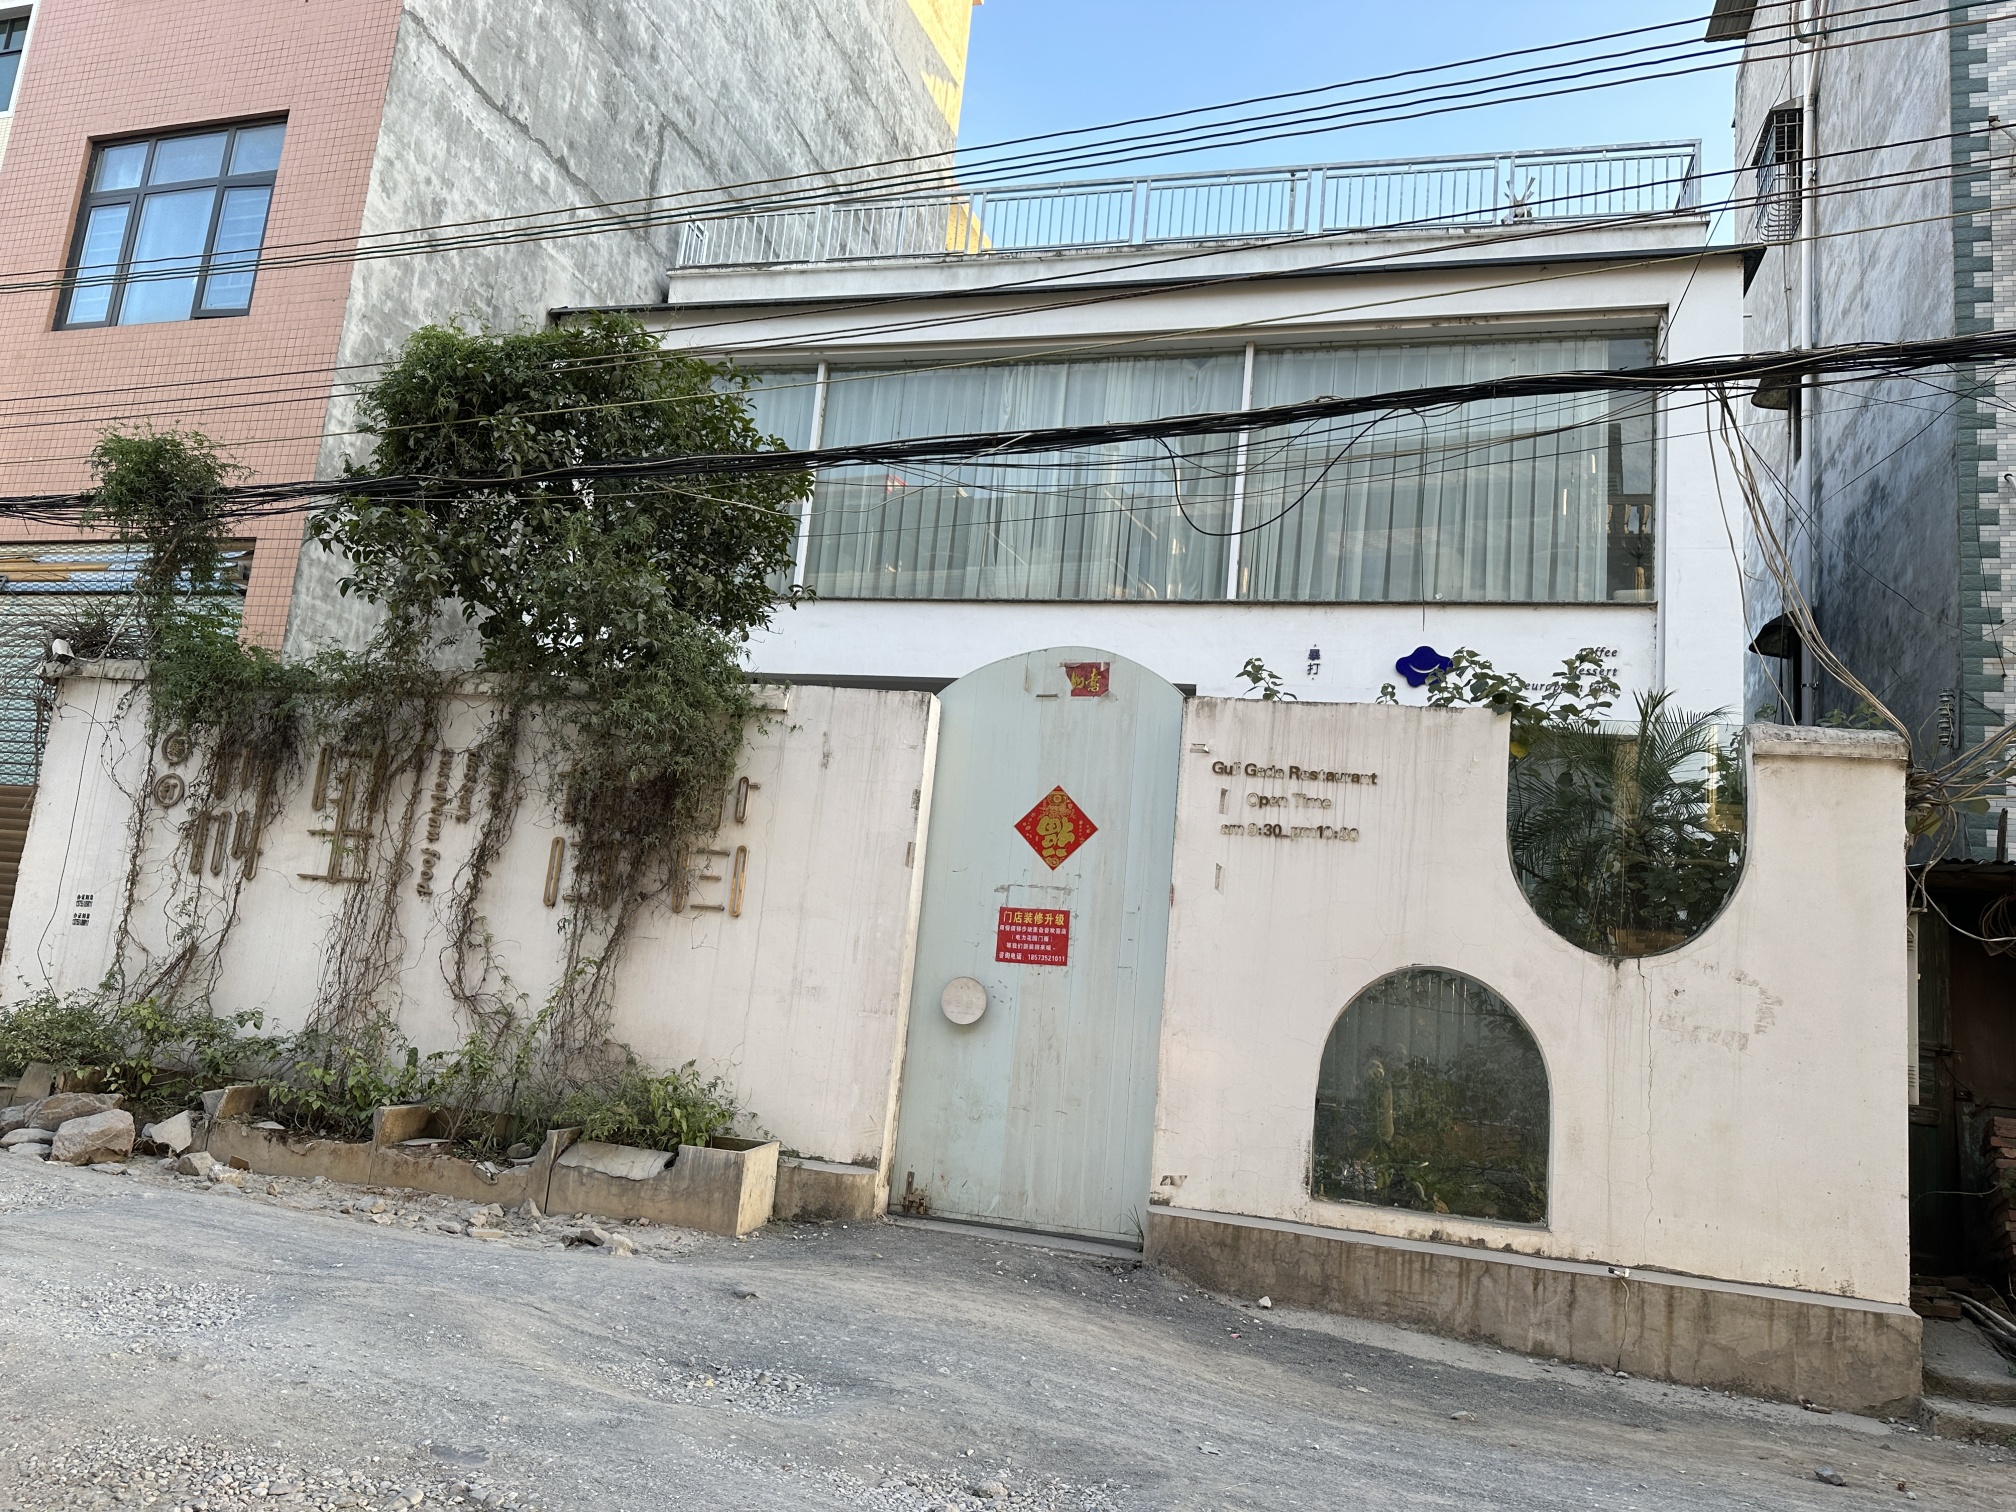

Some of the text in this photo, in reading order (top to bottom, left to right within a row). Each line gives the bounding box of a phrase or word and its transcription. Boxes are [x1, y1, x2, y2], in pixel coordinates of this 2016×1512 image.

[1571, 667, 1618, 677] essert
[1244, 763, 1285, 779] Gada
[1289, 766, 1378, 785] Restaurant
[1246, 792, 1332, 809] Open Time
[1220, 824, 1245, 836] am
[416, 848, 441, 897] food
[1003, 911, 1065, 926] 门店装修升级
